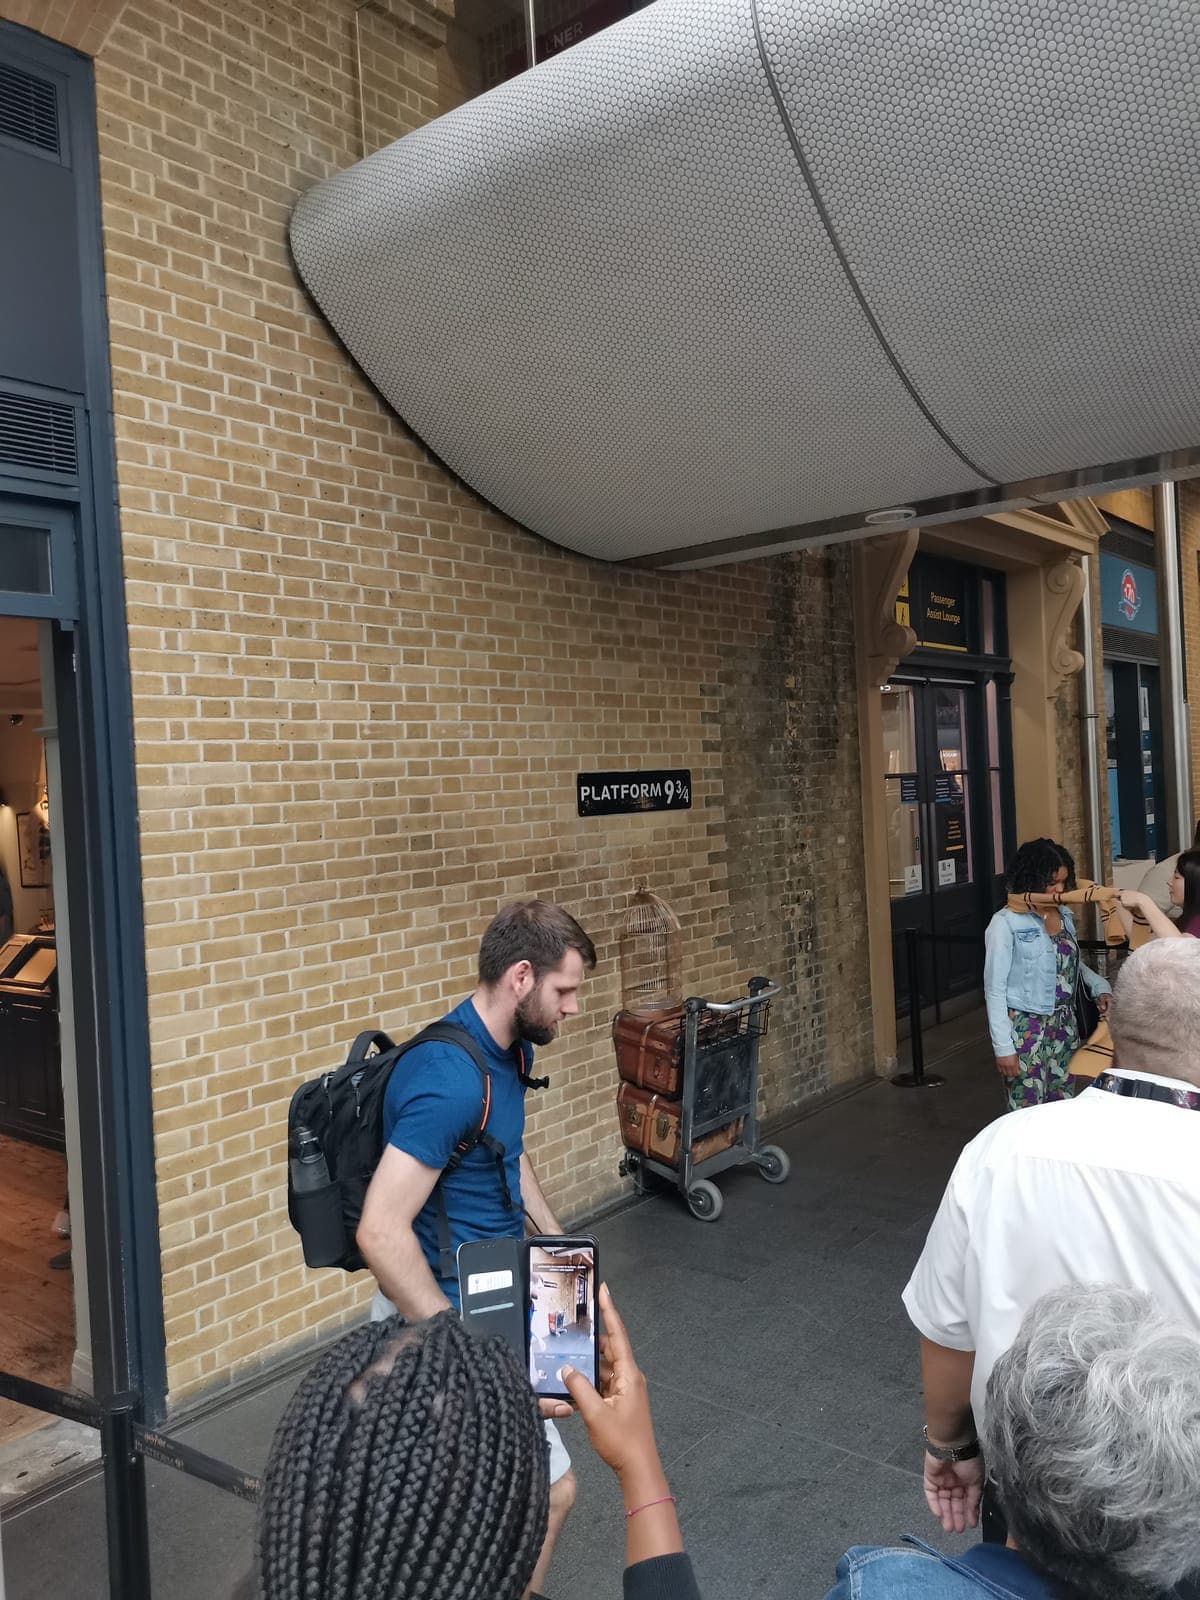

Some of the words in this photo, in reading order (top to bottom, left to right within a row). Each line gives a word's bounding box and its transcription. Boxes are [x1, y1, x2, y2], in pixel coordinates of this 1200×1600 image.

[544, 21, 584, 53] LNER
[930, 591, 956, 608] Passenger
[927, 607, 942, 620] Assist
[942, 610, 961, 625] Lounge
[580, 782, 662, 802] PLATFORM
